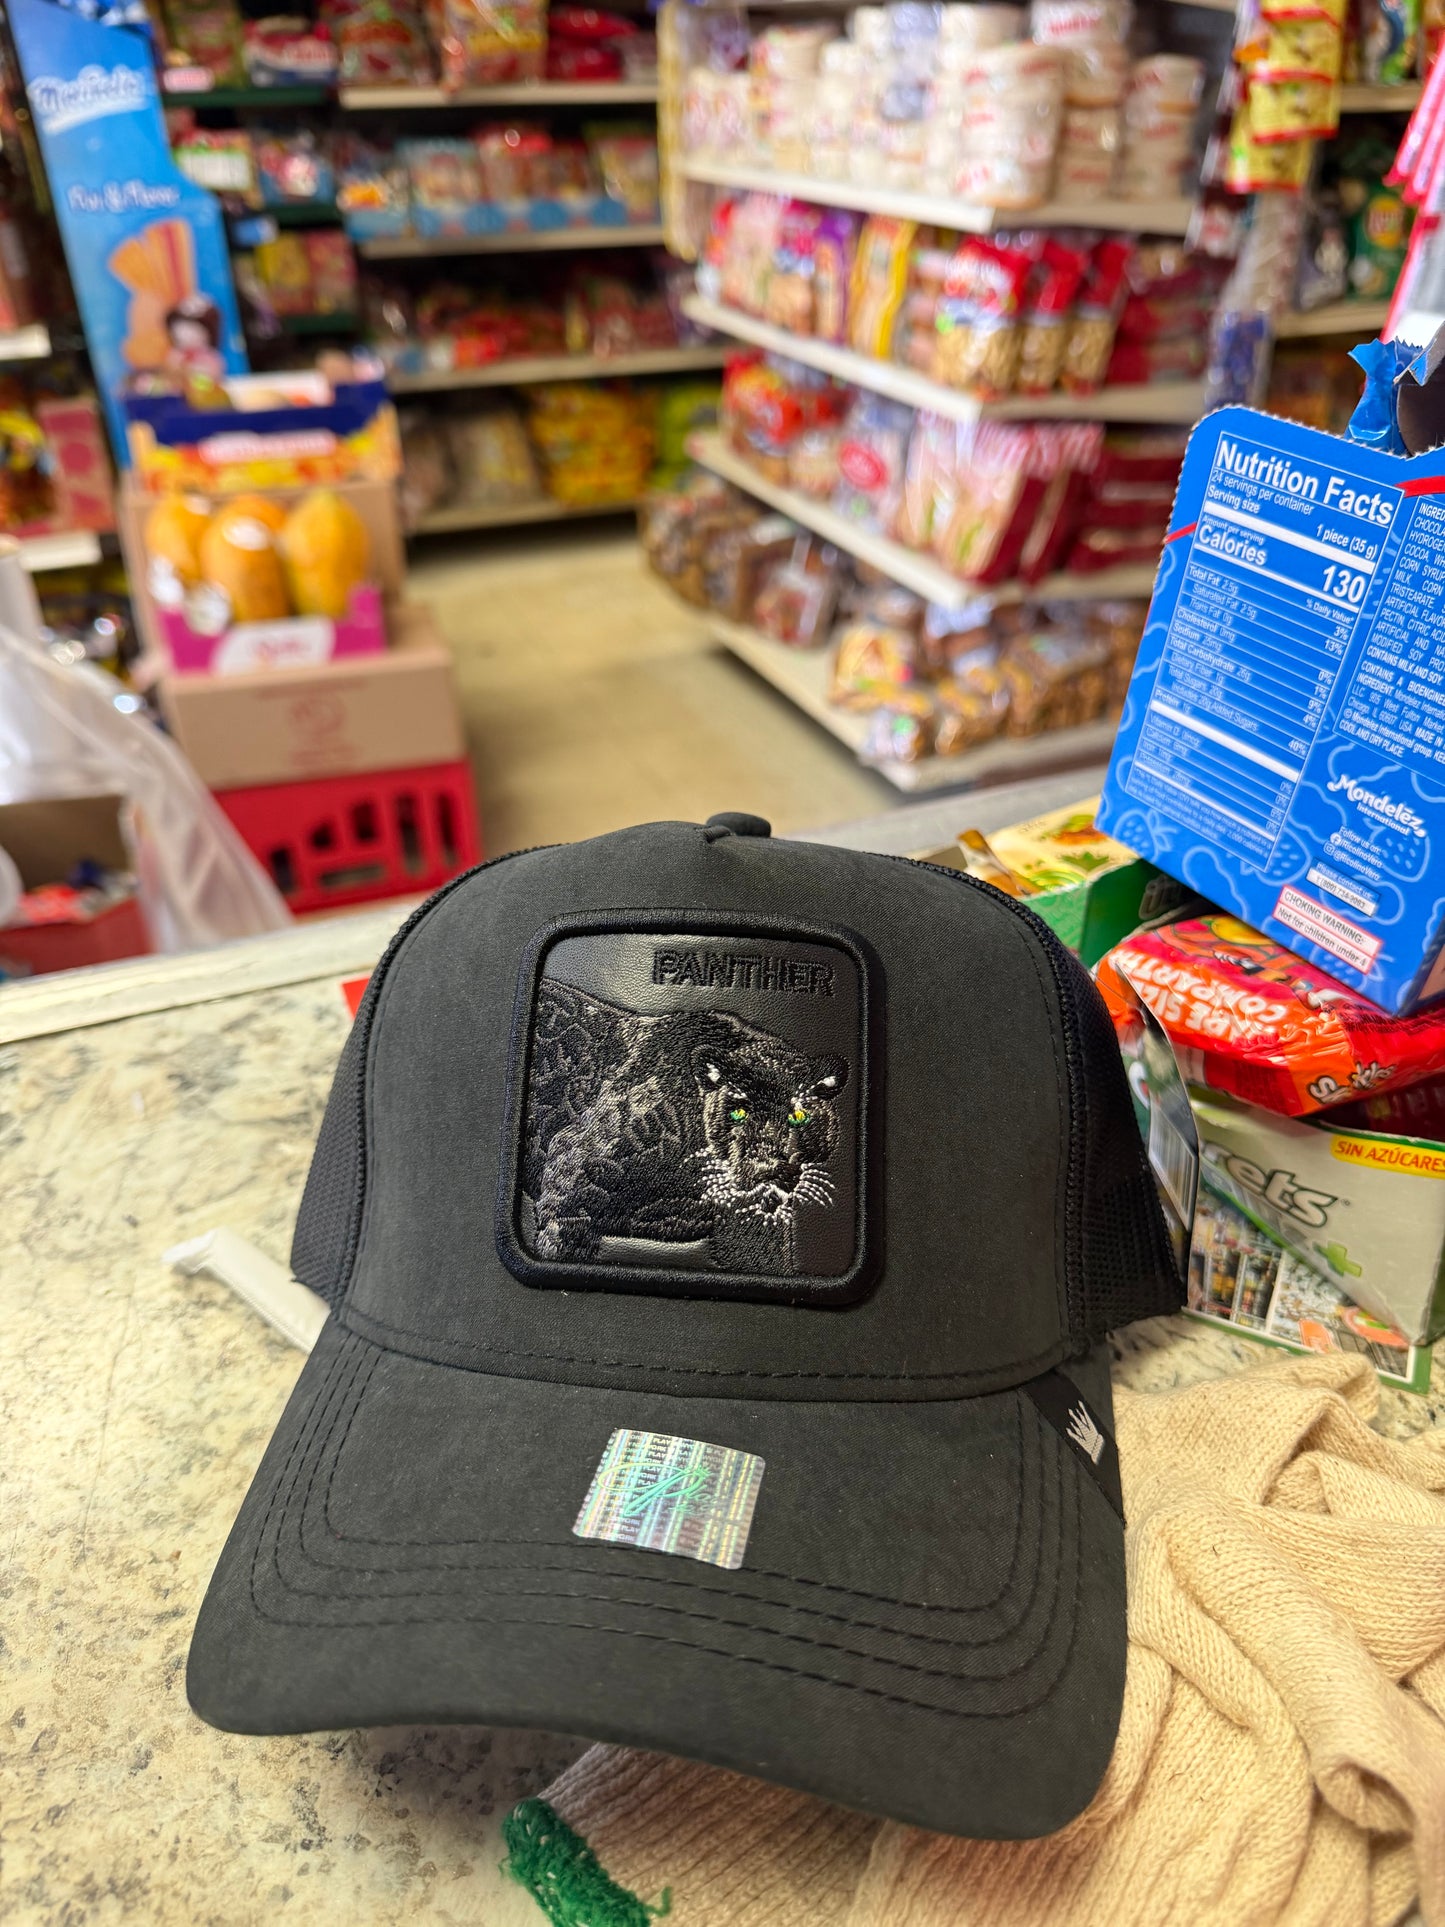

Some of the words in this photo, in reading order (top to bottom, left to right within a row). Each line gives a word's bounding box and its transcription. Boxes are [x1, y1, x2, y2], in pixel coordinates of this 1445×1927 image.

[1210, 470, 1223, 483] 24
[1223, 475, 1257, 497] servings
[1258, 488, 1271, 502] per
[1273, 493, 1313, 515] container
[1216, 440, 1321, 498] Nutrition
[1322, 476, 1397, 524] Facts
[1207, 485, 1241, 509] Serving
[1242, 497, 1260, 513] size
[1203, 515, 1226, 529] Amount
[1227, 525, 1239, 535] per
[1240, 530, 1263, 544] serving
[1314, 523, 1323, 537] 1
[1322, 527, 1349, 548] piece
[1348, 537, 1365, 555] (35
[1365, 543, 1378, 559] g)
[1198, 524, 1268, 565] Calories
[1318, 563, 1367, 603] 130
[1399, 557, 1419, 571] CORN
[1422, 580, 1442, 595] CORN
[1189, 566, 1206, 580] Total
[1206, 573, 1219, 586] Fat
[1333, 626, 1348, 639] 3%
[1207, 605, 1220, 618] Fat
[1313, 603, 1330, 616] Daily
[1385, 596, 1420, 616] ARTIFICIAL
[1174, 622, 1199, 640] Sodium
[1193, 584, 1224, 603] Saturated
[1225, 597, 1238, 610] Fat
[1324, 639, 1343, 655] 13%
[1407, 619, 1429, 635] CITRIC
[1177, 608, 1216, 632] Cholesterol
[1318, 671, 1332, 684] 0%
[1371, 633, 1402, 653] MODIFIED
[1408, 648, 1423, 661] SOY
[1375, 621, 1410, 642] ARTIFICIAL
[1414, 636, 1429, 650] AND
[1170, 636, 1185, 649] Total
[1187, 644, 1234, 674] Carbohydrate
[1308, 699, 1322, 712] 9%
[1361, 661, 1393, 681] CONTAINS
[1396, 676, 1404, 686] A
[1366, 645, 1397, 665] CONTAINS
[1397, 658, 1413, 672] MILK
[1413, 665, 1427, 678] AND
[1339, 720, 1358, 734] COOL
[1356, 727, 1370, 741] AND
[1414, 727, 1433, 742] MADE
[1357, 803, 1409, 835] International
[1339, 826, 1361, 842] Follow
[1360, 839, 1369, 848] us
[1284, 891, 1321, 919] CHOKING
[1322, 914, 1364, 944] WARNING:
[1277, 906, 1289, 919] Not
[1291, 914, 1304, 928] for
[1304, 923, 1335, 947] children
[1336, 944, 1359, 962] under
[652, 950, 836, 997] PANTHER
[1335, 1141, 1363, 1157] SIN
